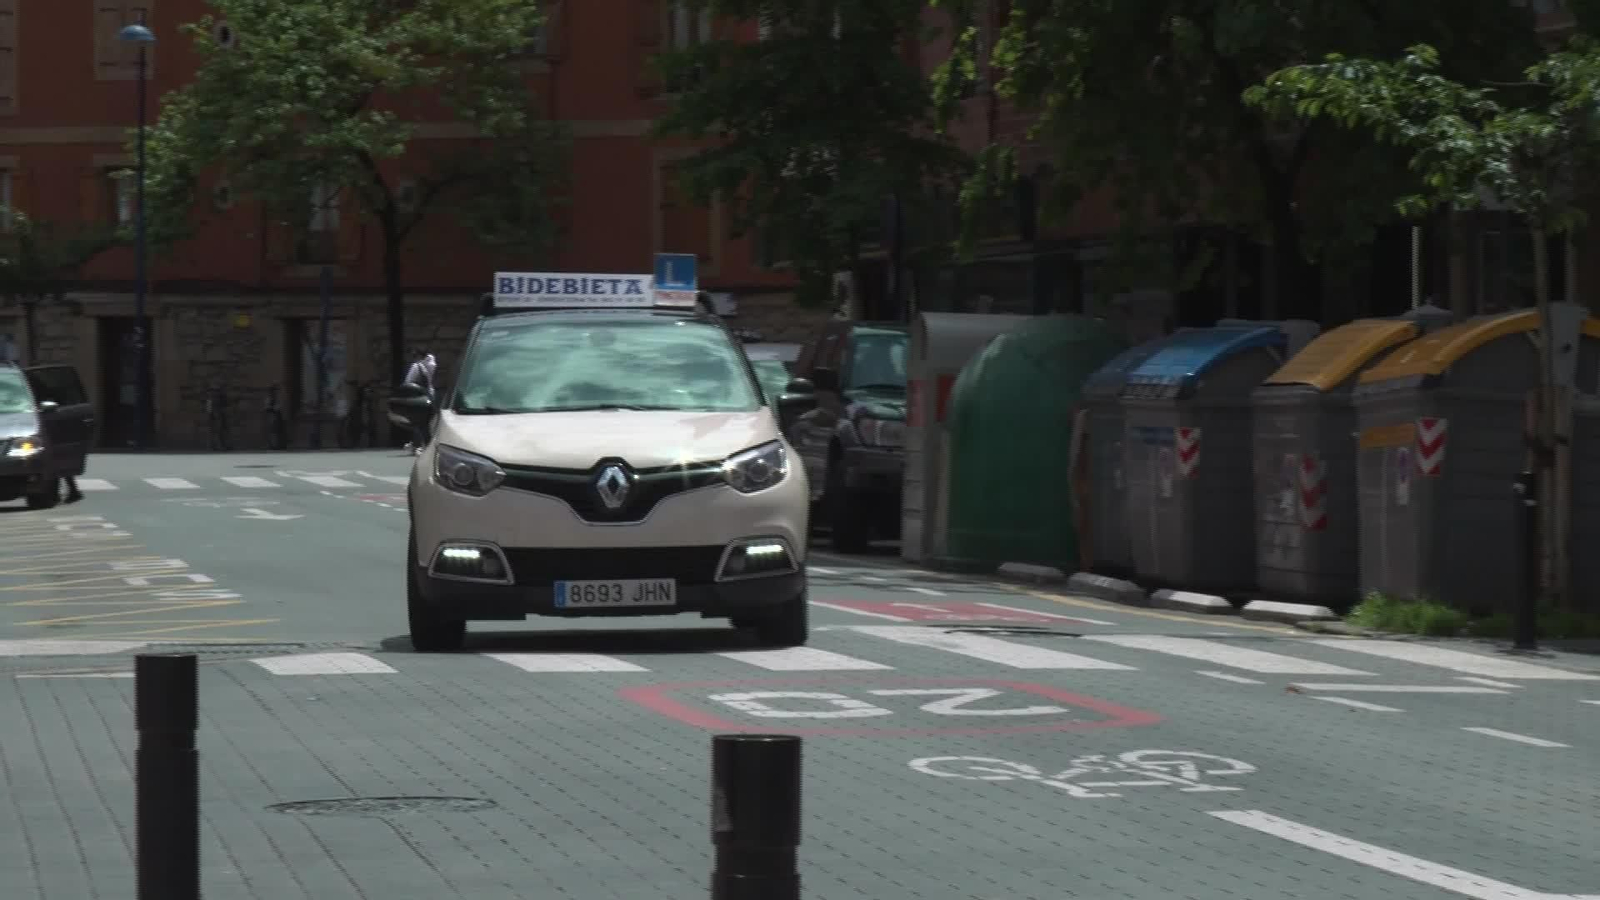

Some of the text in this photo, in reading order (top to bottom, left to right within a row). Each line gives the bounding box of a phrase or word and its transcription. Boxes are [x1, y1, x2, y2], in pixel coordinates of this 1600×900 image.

[666, 261, 686, 287] L
[498, 277, 643, 295] BIDEBIETA
[570, 582, 671, 602] 8693 JHN
